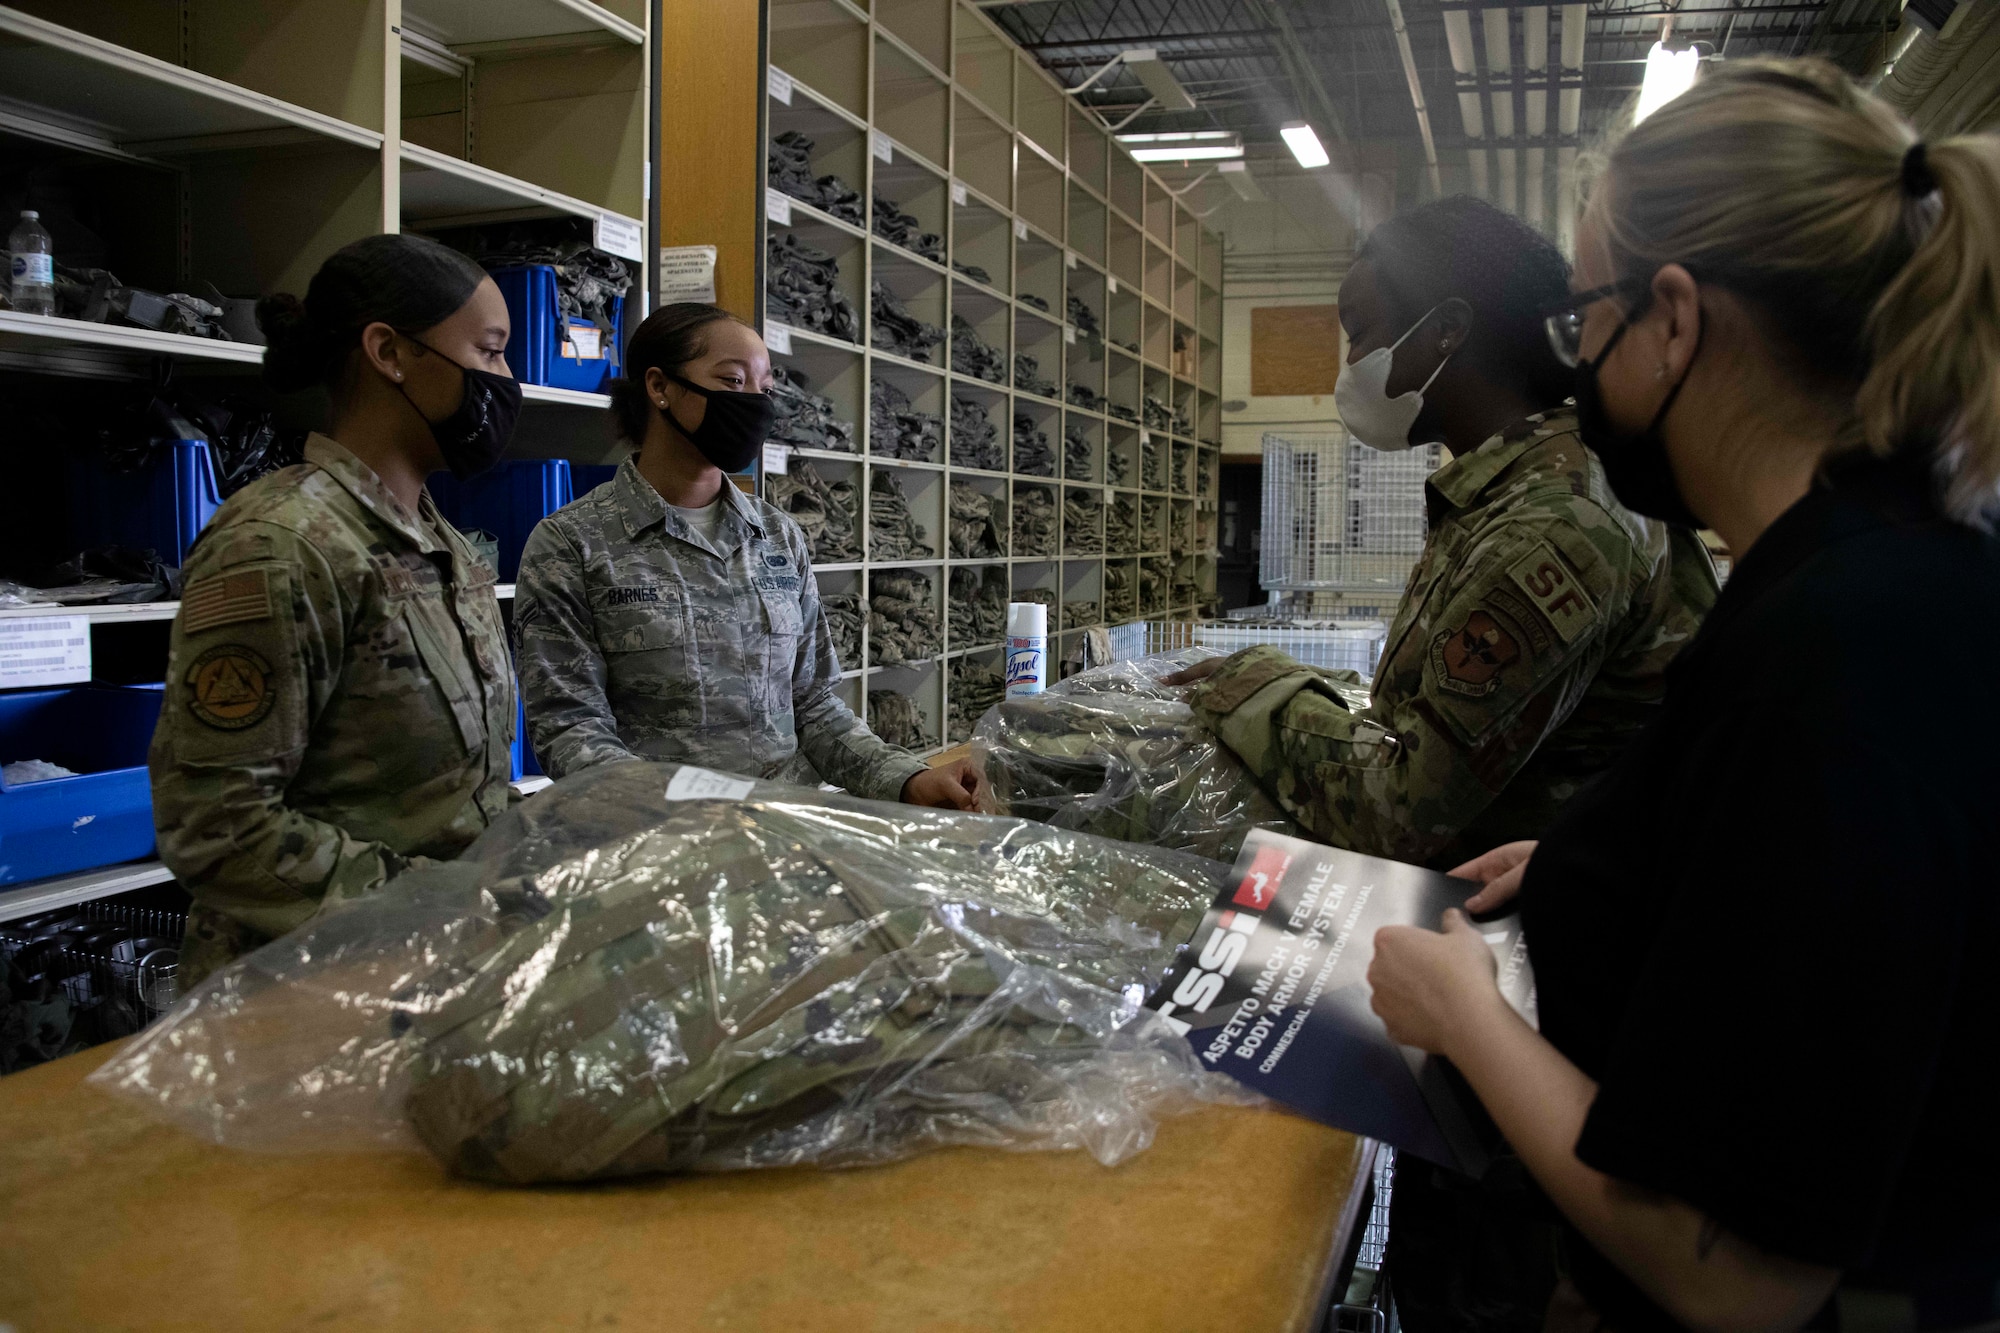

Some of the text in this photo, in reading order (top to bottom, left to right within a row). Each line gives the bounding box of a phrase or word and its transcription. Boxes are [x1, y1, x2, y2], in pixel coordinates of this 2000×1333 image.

[608, 587, 658, 605] BARNES
[1525, 561, 1587, 618] SF
[1494, 594, 1546, 645] DEFENDER
[1007, 654, 1039, 680] Lysol
[1202, 861, 1334, 1064] ASPETTO MACH V FEMALE
[1235, 882, 1349, 1060] BODY ARMOR SYSTEM
[1259, 882, 1375, 1075] COMMERCIAL INSTRUCTION MANUAL
